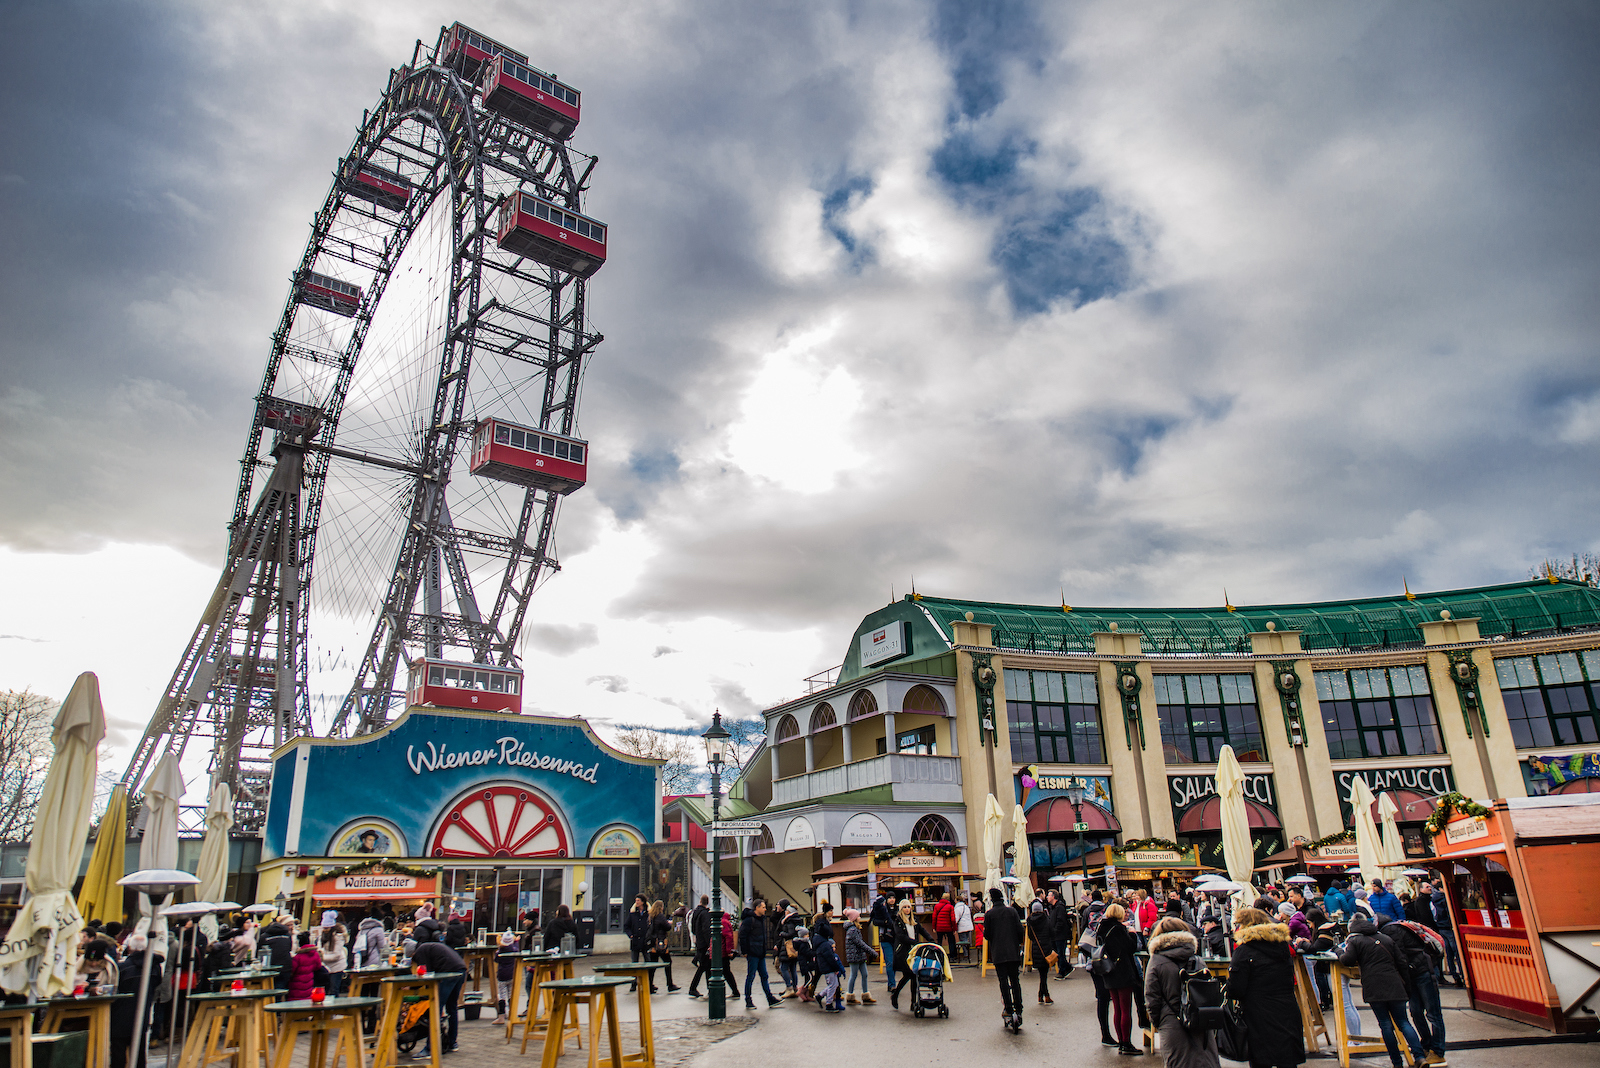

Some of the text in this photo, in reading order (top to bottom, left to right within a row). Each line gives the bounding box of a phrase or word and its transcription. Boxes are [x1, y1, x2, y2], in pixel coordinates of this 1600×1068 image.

[559, 231, 567, 240] 22
[535, 459, 544, 467] 20
[470, 695, 478, 704] 18
[406, 736, 600, 784] Wiener Riesenrad
[1038, 777, 1088, 790] EISMER
[1339, 768, 1450, 801] SLAMUCCI
[1172, 775, 1273, 808] SALACCI
[1265, 838, 1280, 856] DRINKS
[897, 857, 936, 867] Zum Eisvogel
[1132, 852, 1175, 861] Hühnerstall
[343, 876, 410, 888] Waffelmacher
